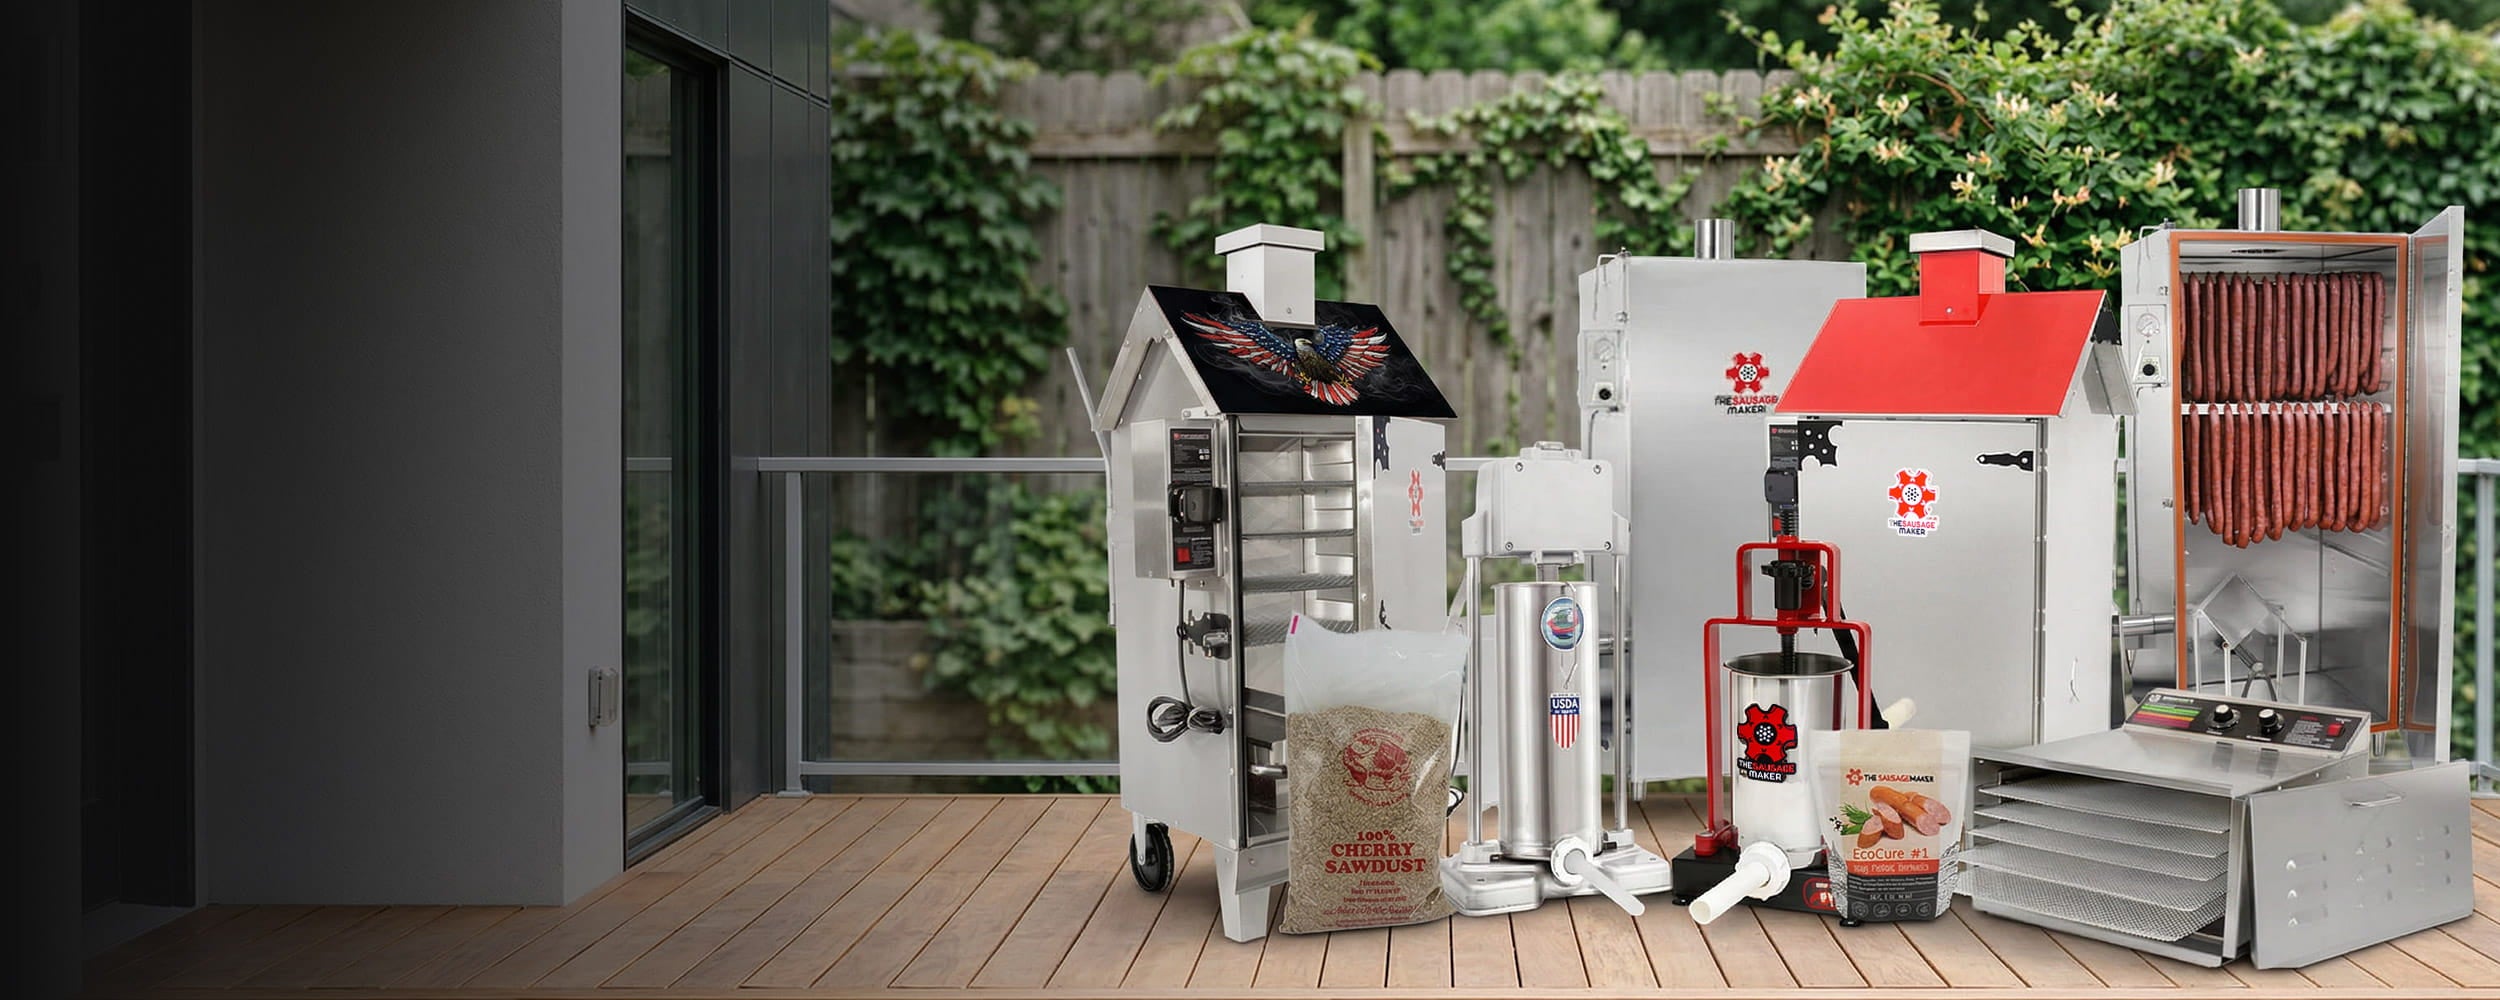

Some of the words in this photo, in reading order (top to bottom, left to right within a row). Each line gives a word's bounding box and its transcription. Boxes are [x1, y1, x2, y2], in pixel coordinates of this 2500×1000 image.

[1899, 527, 1926, 535] MAKER
[1552, 698, 1578, 709] USDA
[1748, 770, 1783, 781] MAKER
[1357, 829, 1396, 841] 100%
[1330, 842, 1415, 858] CHERRY
[1853, 848, 1905, 860] EcoCure
[1911, 847, 1929, 859] #1
[1324, 858, 1426, 874] SAWDUST
